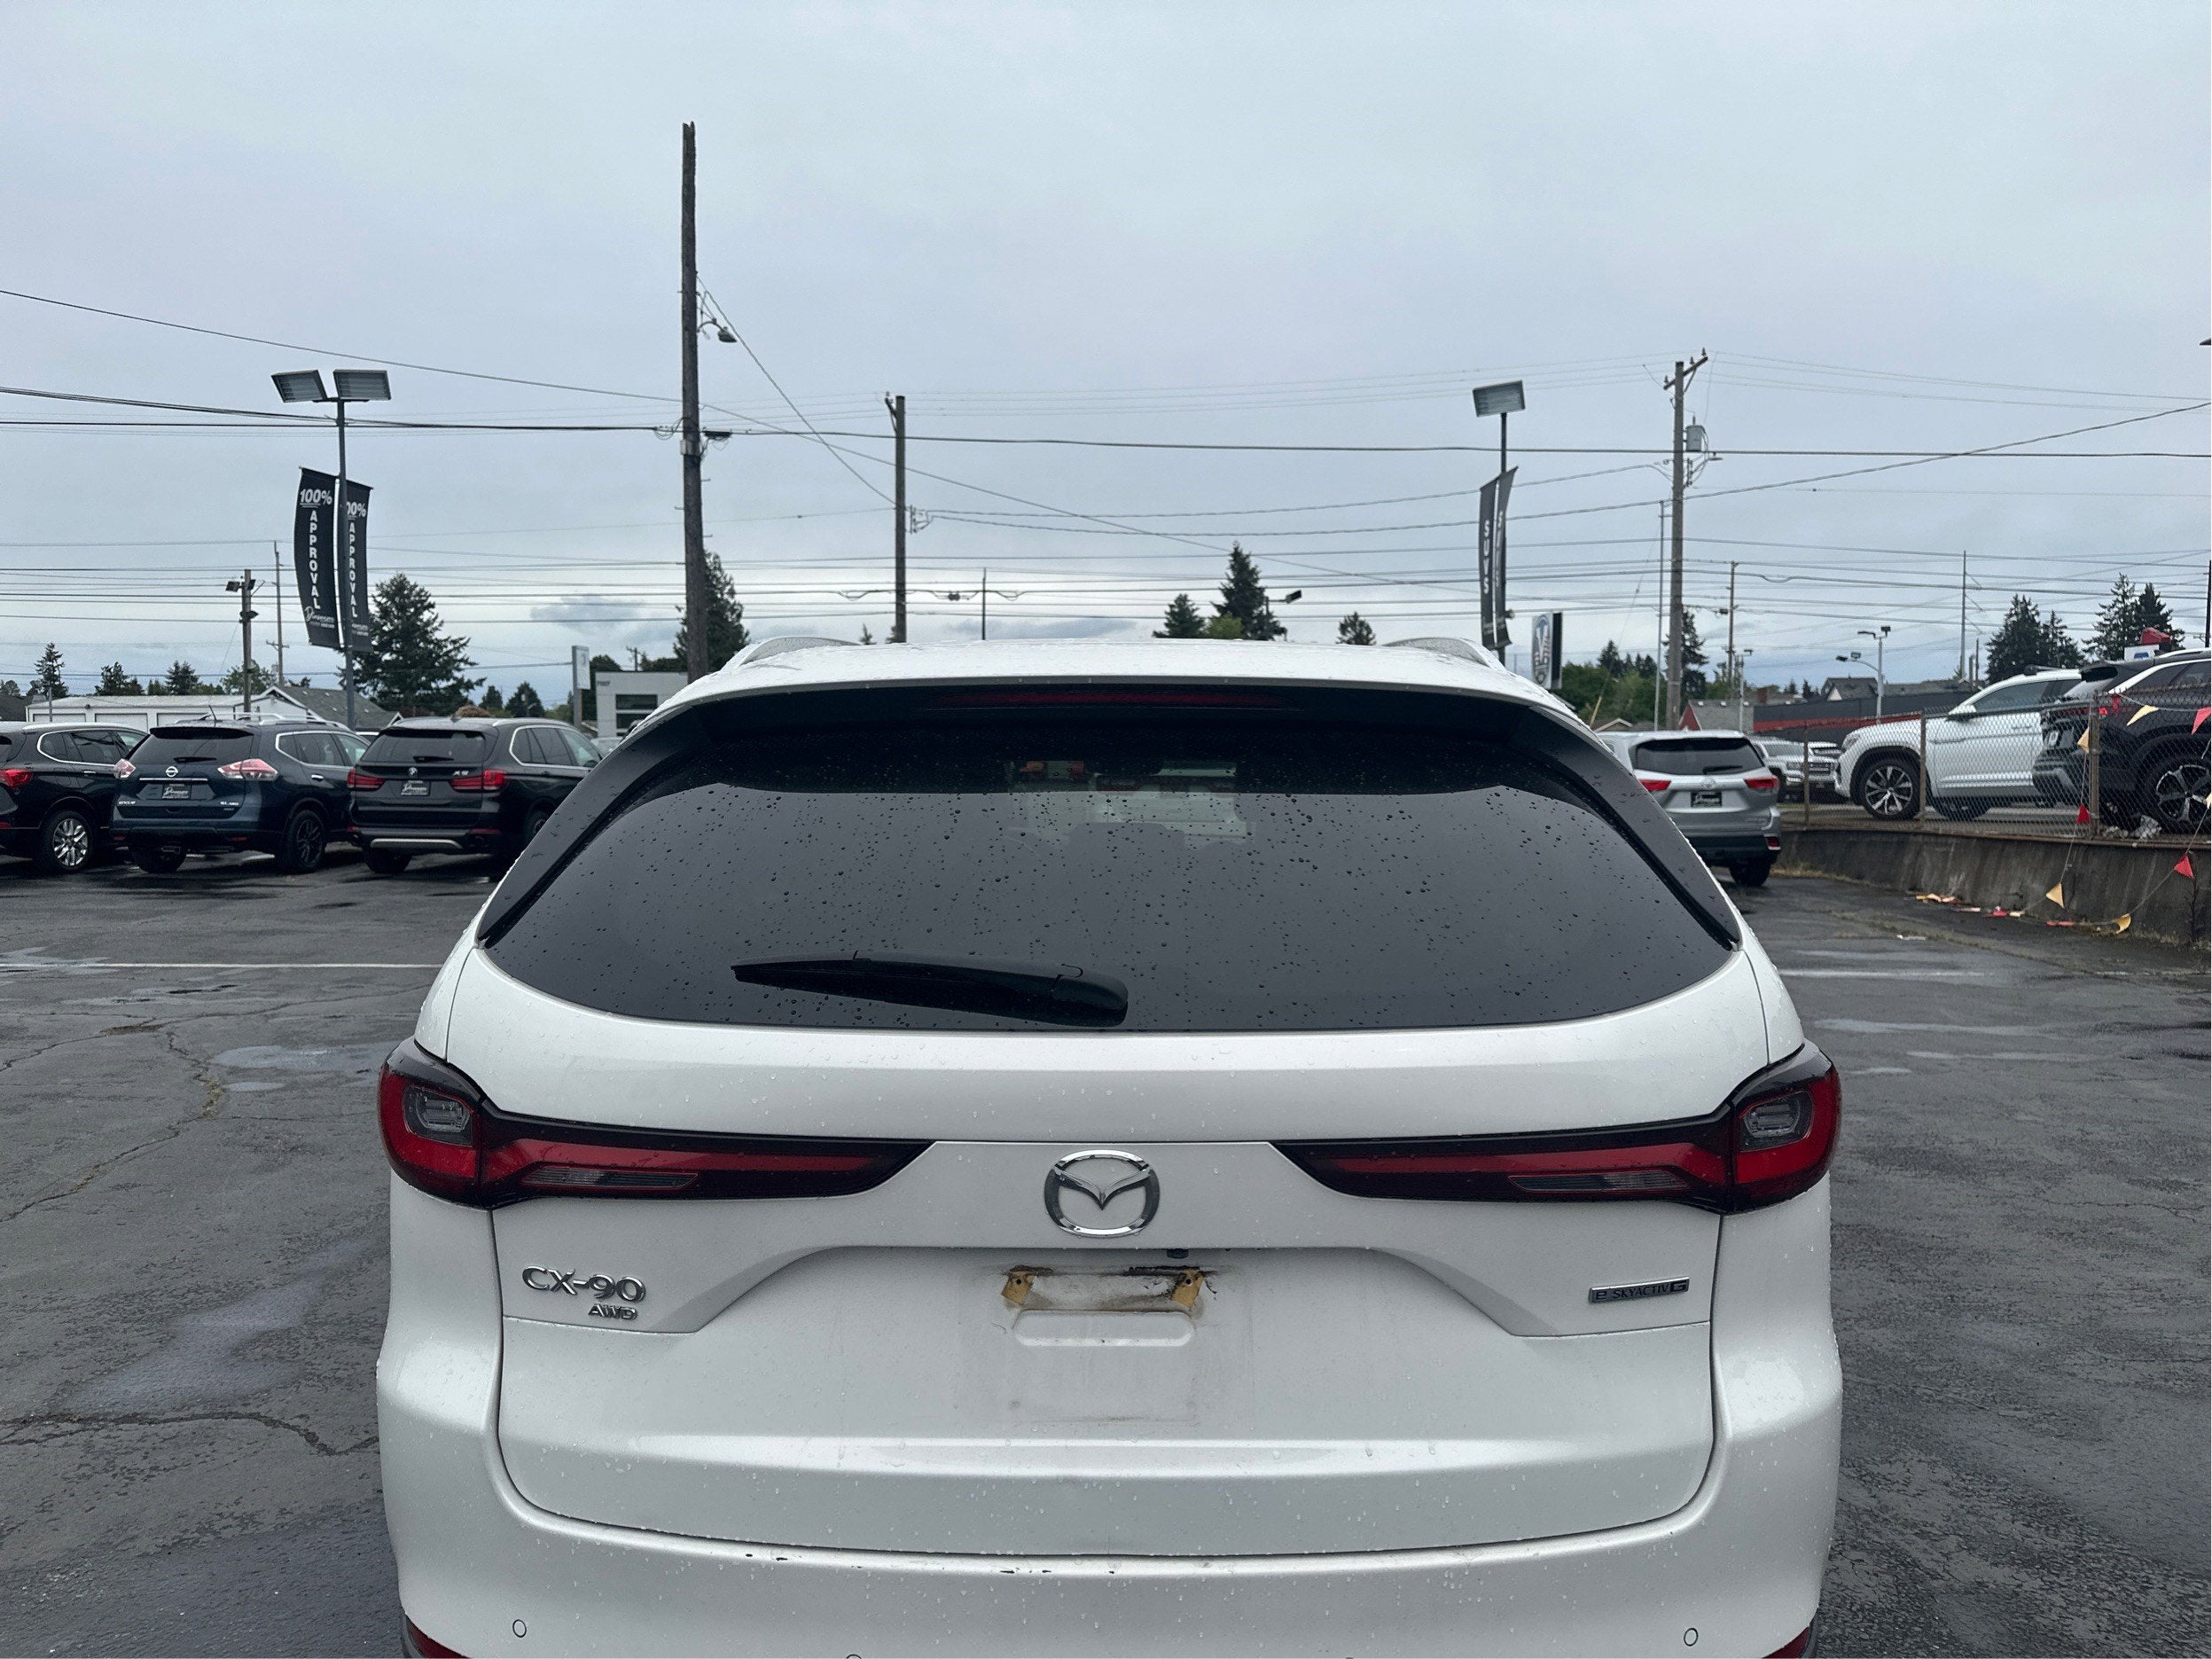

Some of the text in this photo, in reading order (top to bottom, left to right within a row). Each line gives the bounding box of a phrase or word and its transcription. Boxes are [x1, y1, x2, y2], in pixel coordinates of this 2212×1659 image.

[300, 489, 332, 505] 100%
[346, 501, 366, 518] 0%
[309, 510, 320, 609] APPROVAL
[348, 521, 358, 618] APPROVAL
[522, 1265, 646, 1302] CX-90
[588, 1303, 638, 1320] AWD
